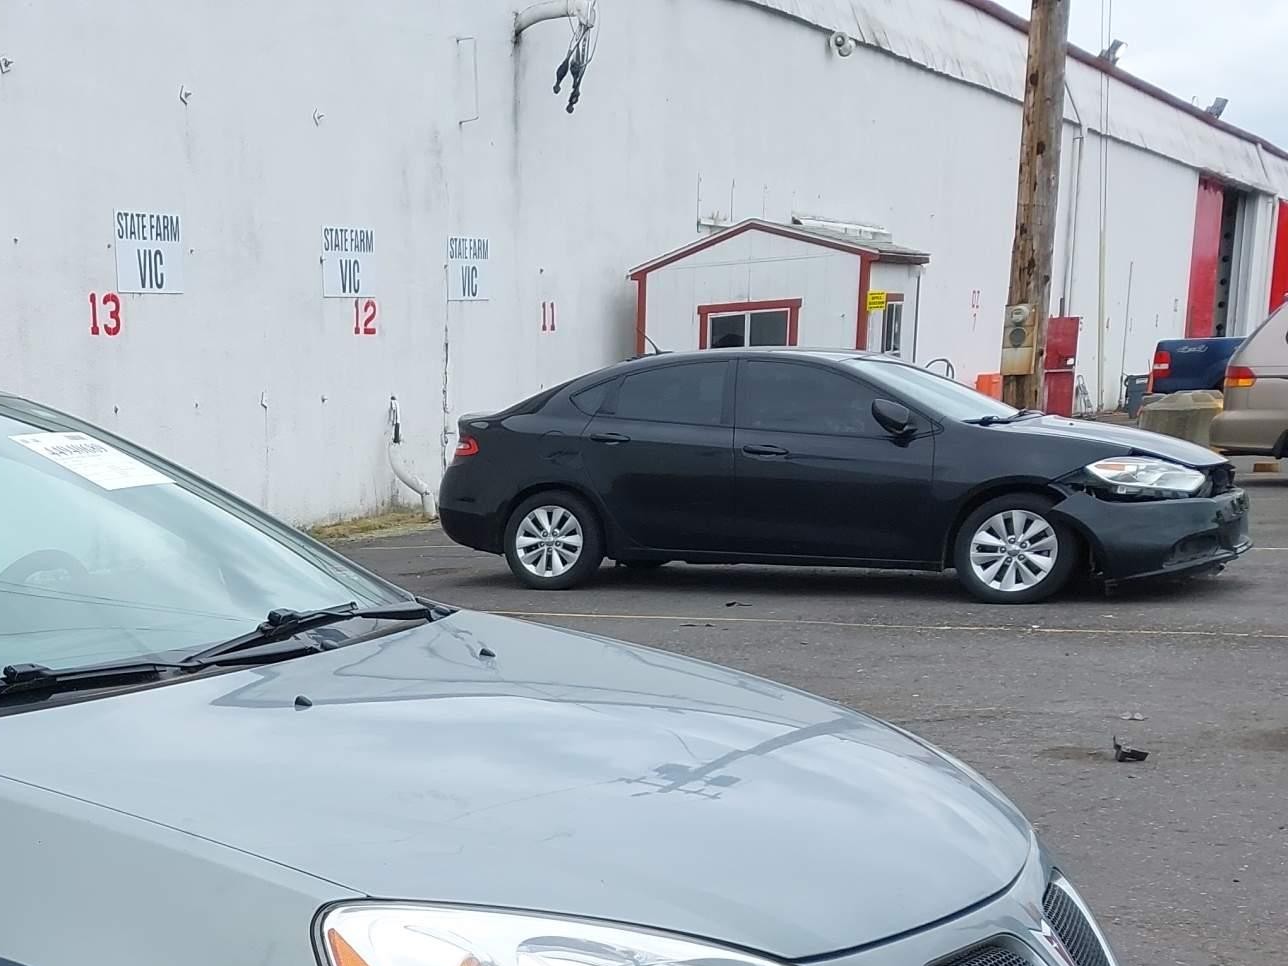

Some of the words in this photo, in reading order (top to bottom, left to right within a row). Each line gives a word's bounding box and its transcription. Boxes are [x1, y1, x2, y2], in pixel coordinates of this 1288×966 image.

[117, 211, 147, 240] STATE
[149, 214, 180, 242] FARM
[324, 227, 348, 252] STATE
[350, 229, 373, 253] FARM
[449, 237, 468, 259] STATE
[469, 238, 489, 260] FARM
[136, 249, 164, 289] VIC
[339, 259, 360, 293] VIC
[461, 265, 478, 297] VIC
[89, 292, 121, 336] 13
[354, 299, 377, 335] 12
[542, 301, 556, 331] 11
